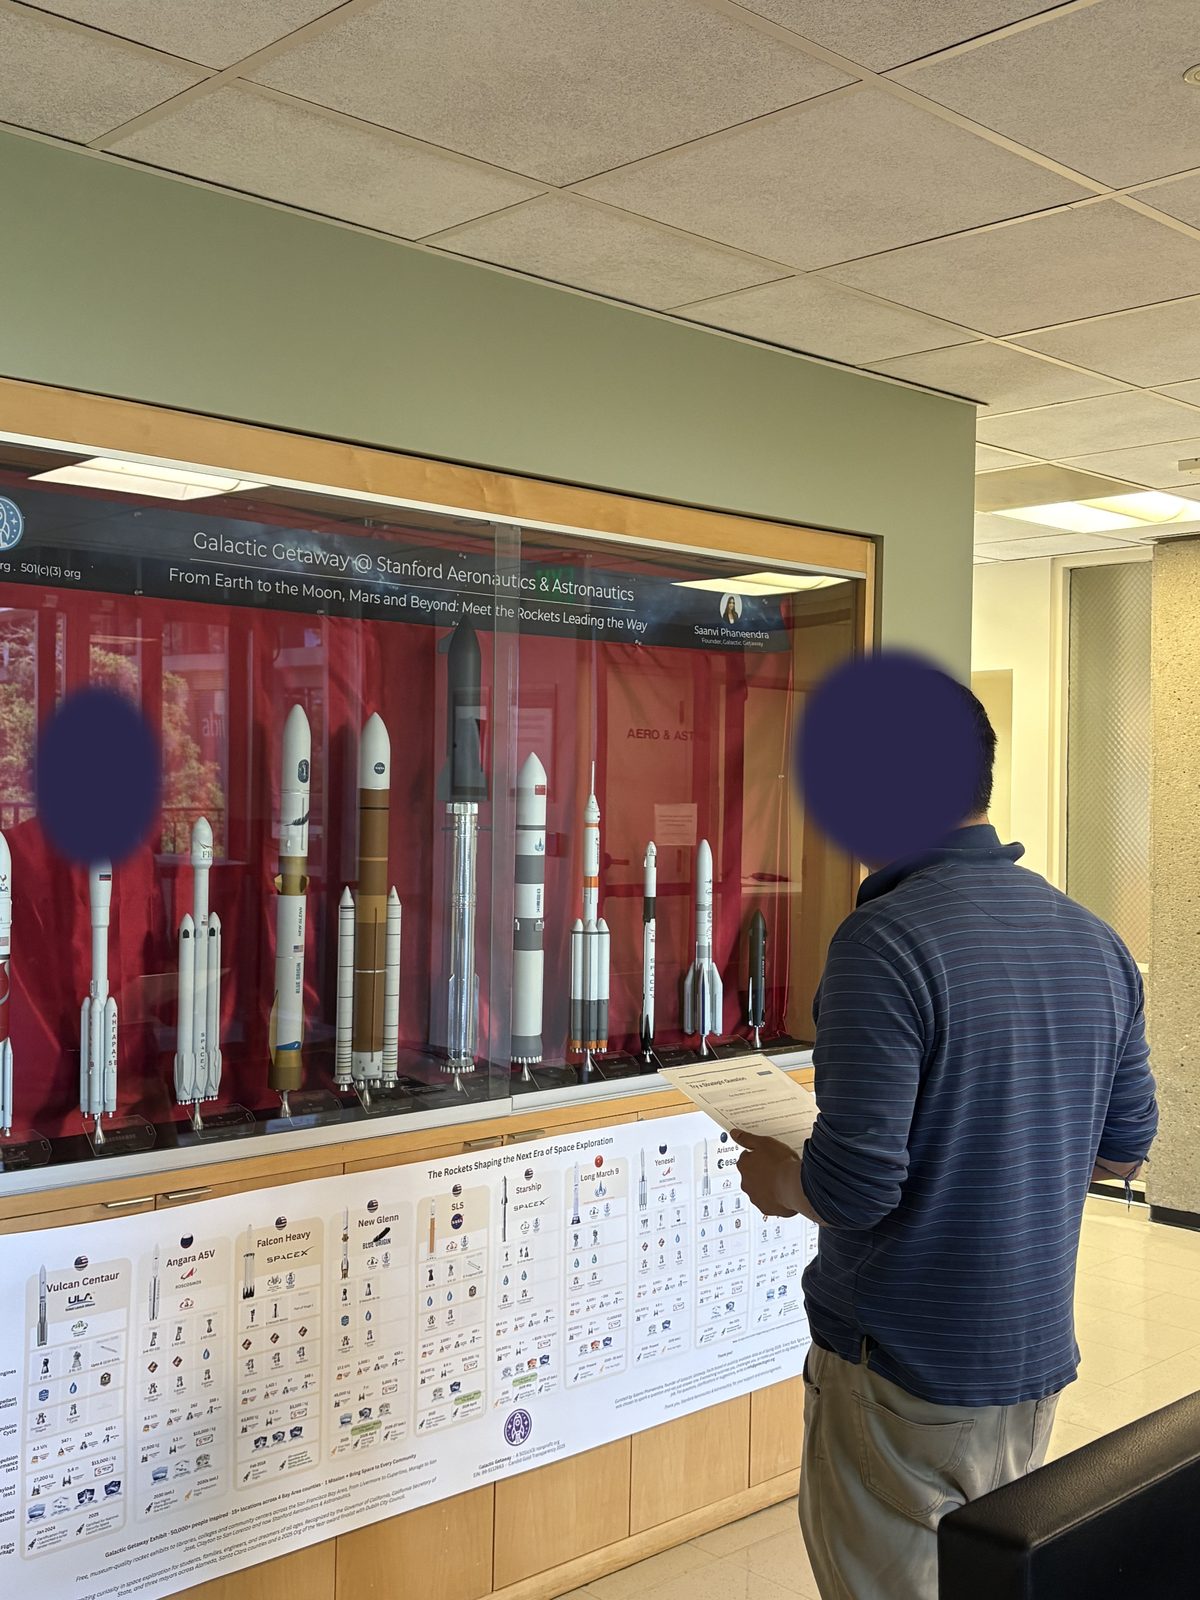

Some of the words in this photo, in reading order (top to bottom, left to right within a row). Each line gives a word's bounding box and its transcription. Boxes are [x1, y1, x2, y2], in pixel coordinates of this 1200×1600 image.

[20, 563, 61, 578] 501(c)(3)
[64, 570, 81, 580] org
[193, 532, 267, 558] Galactic
[272, 543, 350, 572] Getaway
[355, 554, 373, 574] @
[376, 556, 443, 579] Stanford
[447, 566, 536, 590] Aeronautics
[539, 577, 550, 592] &
[551, 578, 635, 602] Astronautics
[169, 567, 210, 586] From
[215, 573, 253, 590] Earth
[257, 579, 272, 592] to
[275, 581, 299, 595] the
[302, 584, 345, 602] Moon,
[350, 589, 381, 604] Mars
[384, 594, 407, 607] and
[411, 596, 459, 612] Beyond:
[462, 602, 492, 616] Meet
[495, 604, 515, 618] the
[518, 607, 560, 623] Rockets
[563, 611, 604, 629] Leading
[607, 616, 623, 629] the
[626, 618, 648, 634] Way
[694, 625, 719, 636] Saanvi
[720, 627, 769, 639] Phaneendra
[627, 728, 660, 740] AERO
[663, 730, 670, 740] &
[427, 1169, 443, 1180] The
[443, 1163, 473, 1177] Rockets
[473, 1157, 502, 1171] Shaping
[502, 1155, 515, 1164] the
[515, 1152, 532, 1162] Next
[533, 1149, 545, 1158] Era
[545, 1147, 553, 1156] of
[553, 1144, 575, 1155] Space
[576, 1136, 614, 1150] Exploration
[716, 1146, 734, 1154] Ariane
[580, 1173, 596, 1184] Long
[596, 1169, 615, 1180] March
[615, 1167, 620, 1176] 9
[515, 1182, 542, 1195] Starship
[451, 1201, 465, 1211] SLS
[358, 1218, 375, 1228] New
[376, 1213, 399, 1225] Glenn
[257, 1235, 284, 1248] Falcon
[285, 1230, 311, 1244] Heavy
[166, 1255, 196, 1268] Angara
[198, 1249, 216, 1261] A5V
[266, 1246, 314, 1263] SPACEX
[46, 1279, 80, 1293] Vulcan
[81, 1271, 120, 1287] Centaur
[105, 1547, 127, 1558] Galactic
[127, 1539, 150, 1553] Getaway
[150, 1533, 168, 1543] Exhibit
[191, 1518, 208, 1530] people
[209, 1511, 229, 1522] inspired
[240, 1502, 262, 1512] locations
[380, 1460, 392, 1469] Every
